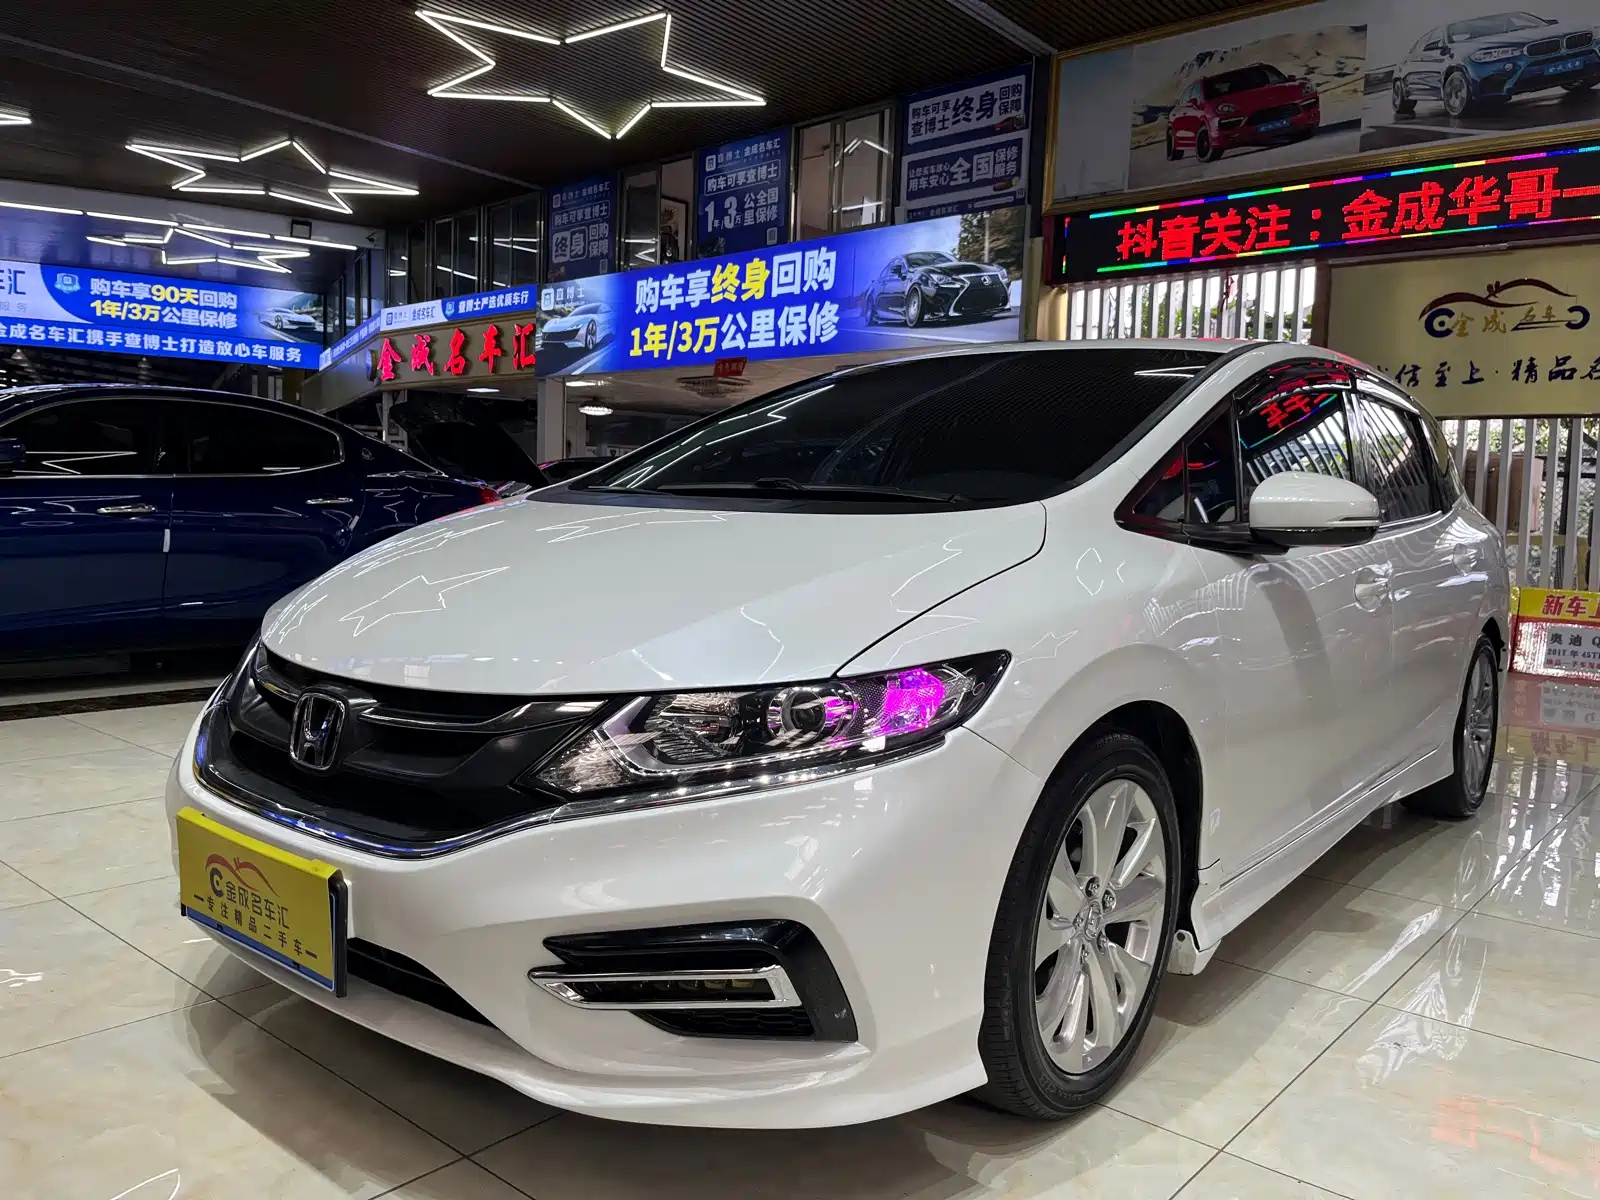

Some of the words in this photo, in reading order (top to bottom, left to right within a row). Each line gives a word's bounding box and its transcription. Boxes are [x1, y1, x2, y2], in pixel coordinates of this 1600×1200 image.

[1000, 83, 1023, 100] 回购
[912, 100, 951, 120] 购车可享
[951, 90, 998, 126] 终身
[911, 115, 950, 138] 查博士
[949, 151, 994, 186] 全国
[995, 146, 1018, 163] 保修
[707, 163, 778, 193] 购车可享查博士
[908, 173, 949, 192] 用车安心
[554, 232, 585, 259] 终身
[90, 277, 238, 310] 购车享90天回购
[635, 246, 837, 314] 购车享终身回购
[90, 300, 238, 329] 1年/3万公里保修
[629, 301, 840, 361] 1年/3万公里保修
[1550, 633, 1583, 648] 奥迪
[225, 880, 291, 930] 金成名车汇
